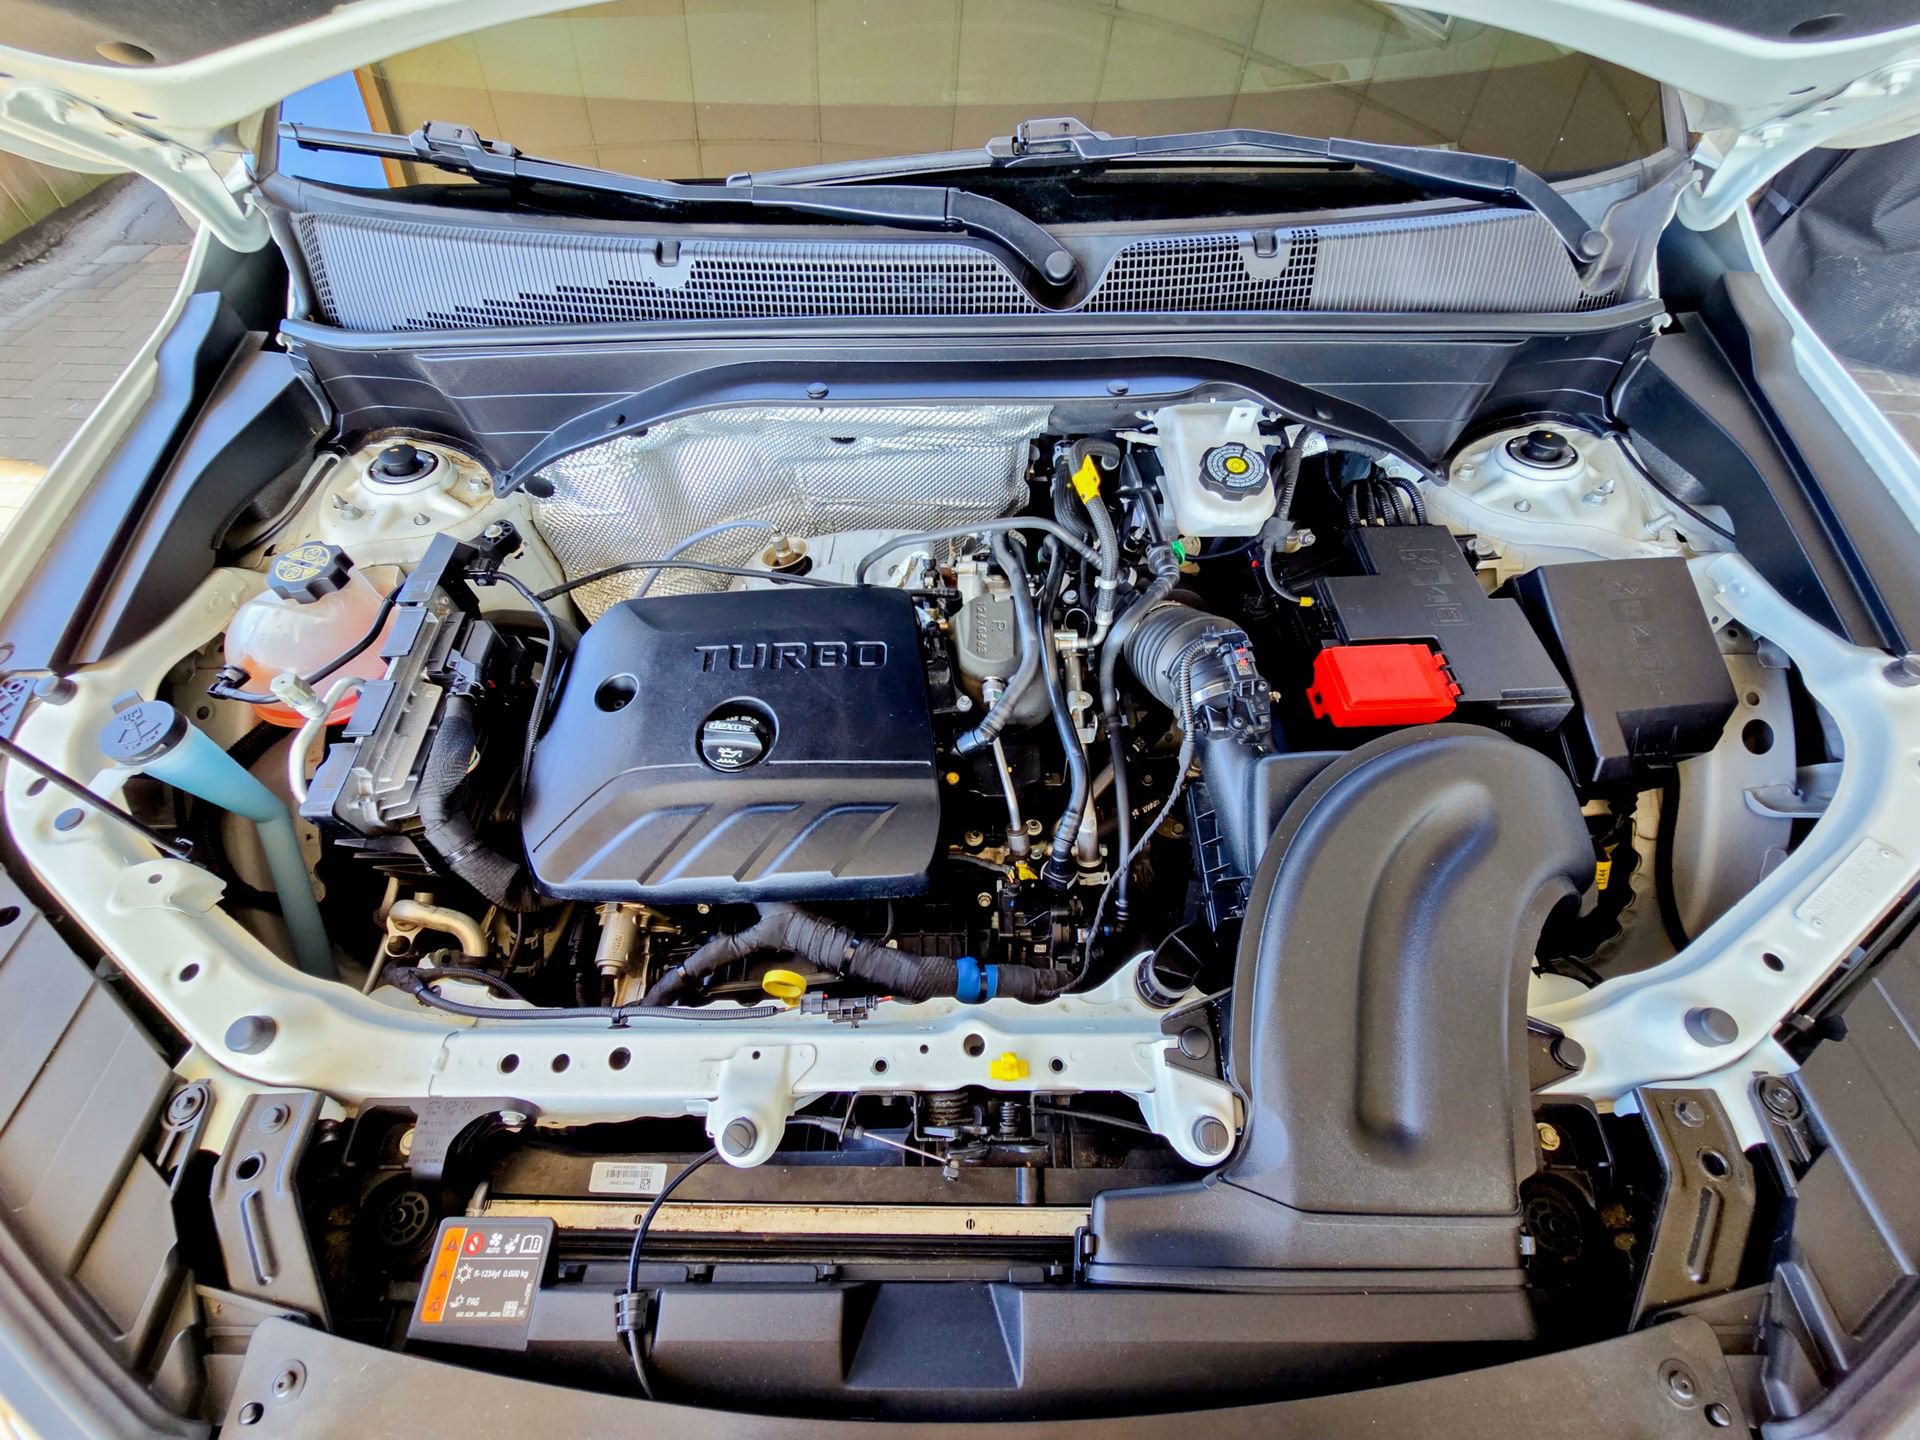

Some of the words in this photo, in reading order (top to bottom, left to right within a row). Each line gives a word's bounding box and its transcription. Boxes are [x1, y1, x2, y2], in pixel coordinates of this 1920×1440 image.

[693, 641, 888, 673] TURBO
[708, 720, 753, 732] dexos
[485, 1246, 501, 1254] AUTO
[520, 1269, 529, 1279] kg
[465, 1296, 480, 1306] PAG
